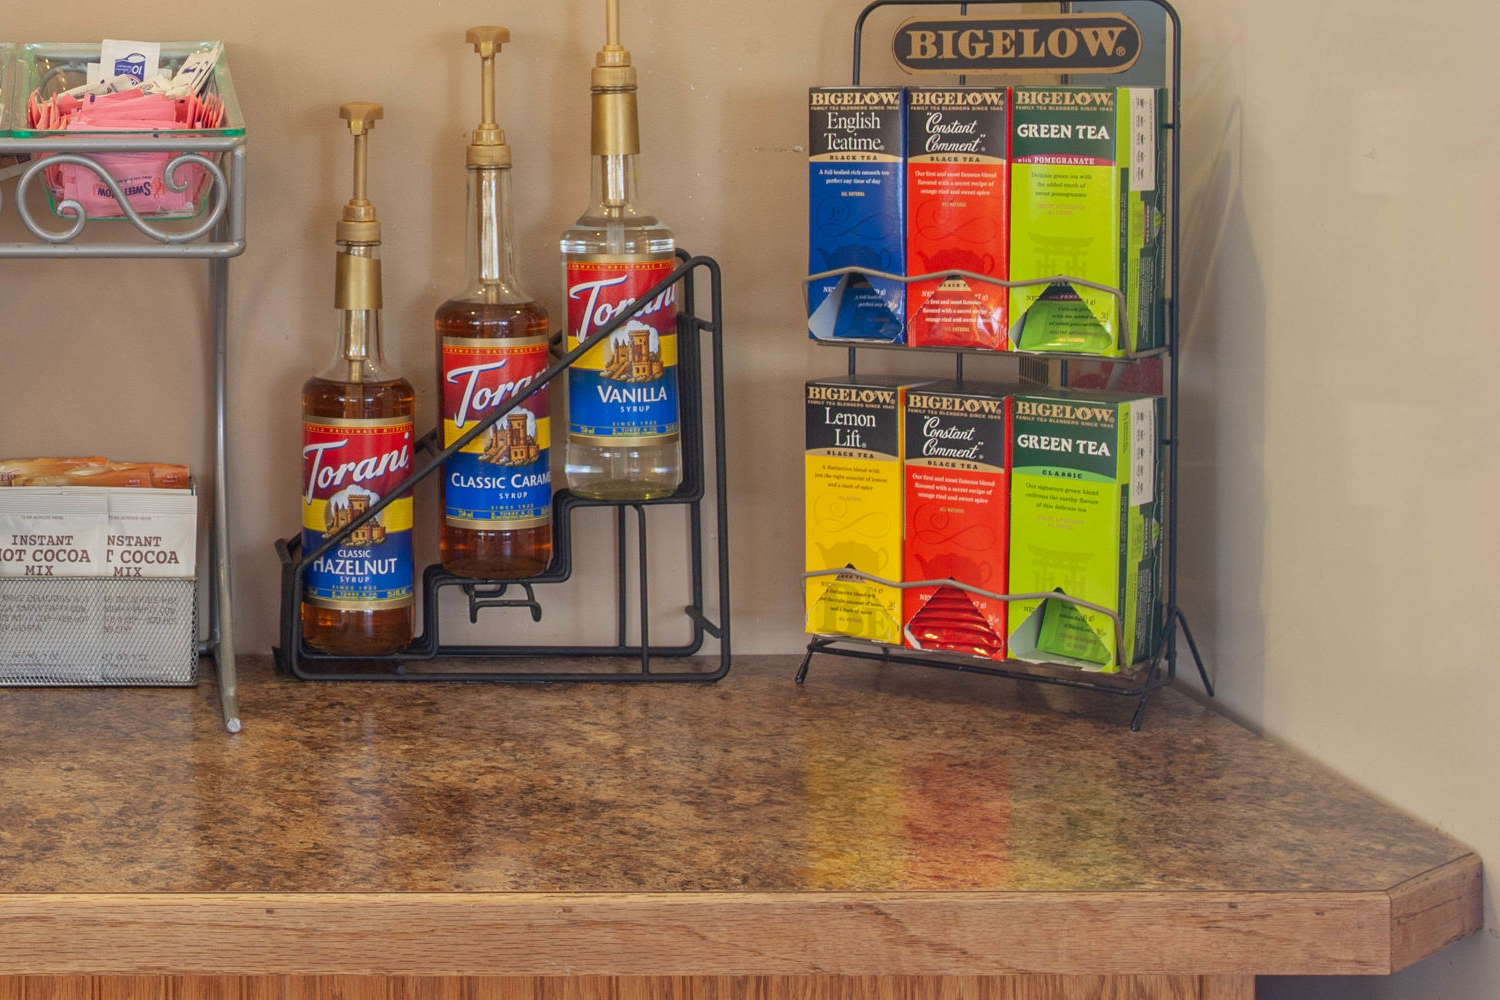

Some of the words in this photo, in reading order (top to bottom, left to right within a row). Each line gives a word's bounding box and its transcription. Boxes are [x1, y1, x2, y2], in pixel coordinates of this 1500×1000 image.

[906, 26, 1127, 59] BIGELOW
[811, 92, 899, 105] BIGELOW
[910, 92, 1004, 105] BIGELOW
[1016, 91, 1113, 106] BIGELOW
[827, 112, 880, 133] English
[1017, 124, 1072, 138] GREEN
[1076, 125, 1110, 139] TEA
[824, 133, 881, 150] Teatime
[447, 359, 549, 428] Tora
[597, 385, 667, 403] VANILLA
[807, 386, 895, 404] BIGELOW
[908, 394, 1001, 414] BIGELOW
[1016, 401, 1114, 422] BIGELOW
[825, 407, 876, 427] Lemon
[835, 429, 861, 447] Lift
[1017, 434, 1072, 453] GREEN
[1076, 440, 1110, 456] TEA
[303, 432, 409, 505] Torani
[1042, 470, 1082, 479] CLASSIC
[452, 473, 505, 489] CLASSIC
[511, 471, 551, 488] CARAME
[12, 535, 74, 546] INSTANT
[107, 535, 161, 547] NSTANT
[32, 549, 91, 563] COCOA
[121, 550, 180, 564] COCOA
[337, 550, 371, 558] CLASSIC
[25, 565, 54, 576] MIX
[113, 567, 142, 577] MIX
[314, 556, 397, 575] HAZELNUT
